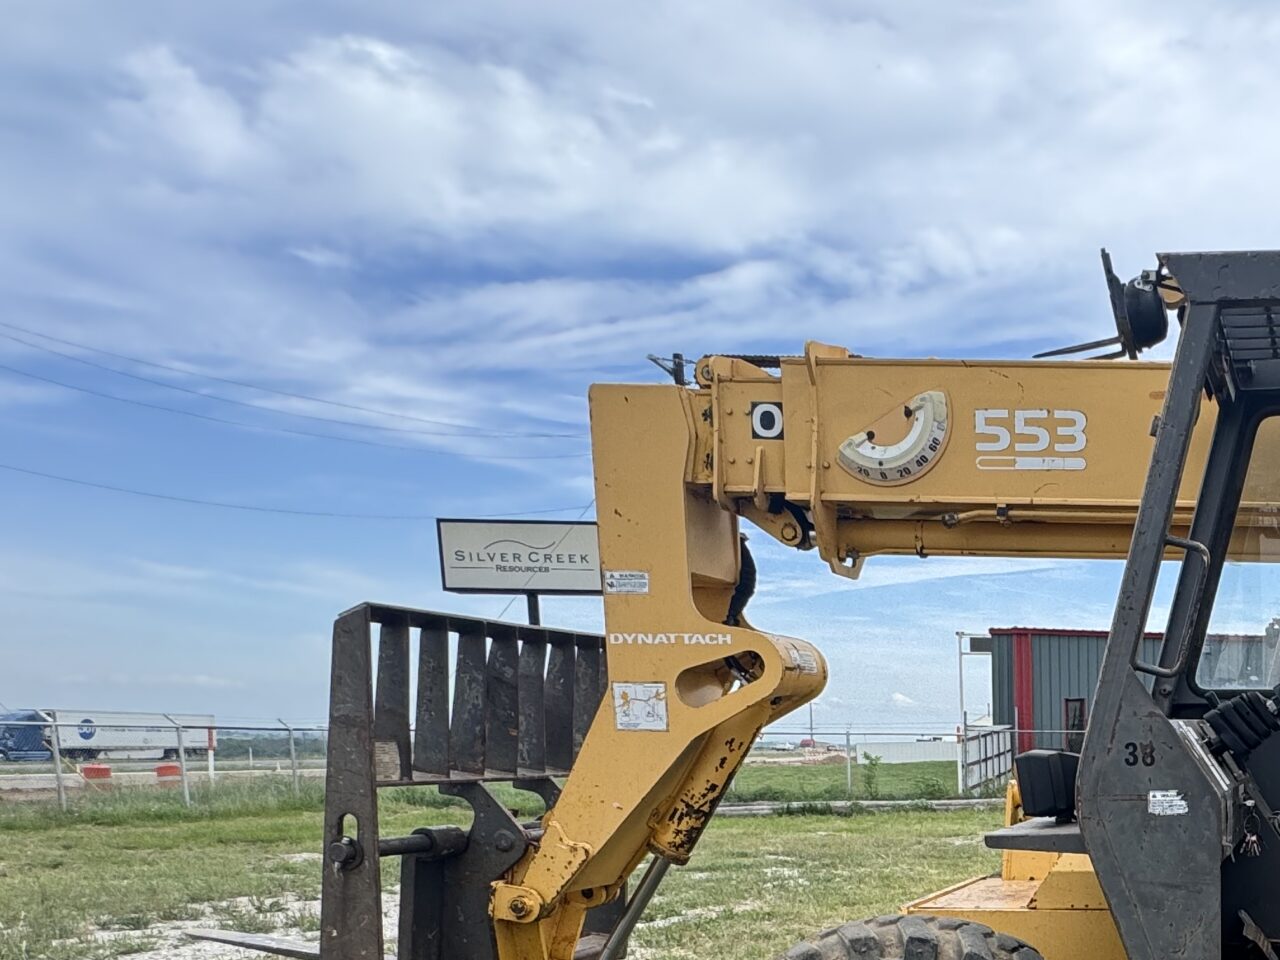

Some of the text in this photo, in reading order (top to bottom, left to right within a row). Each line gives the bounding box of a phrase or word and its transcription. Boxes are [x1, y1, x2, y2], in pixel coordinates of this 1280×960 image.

[975, 409, 1087, 452] 553
[856, 436, 942, 480] 20 0 20 40 60
[454, 549, 590, 564] SILVER CREEK
[609, 633, 732, 645] DYNATTACH
[1124, 742, 1156, 767] 38
